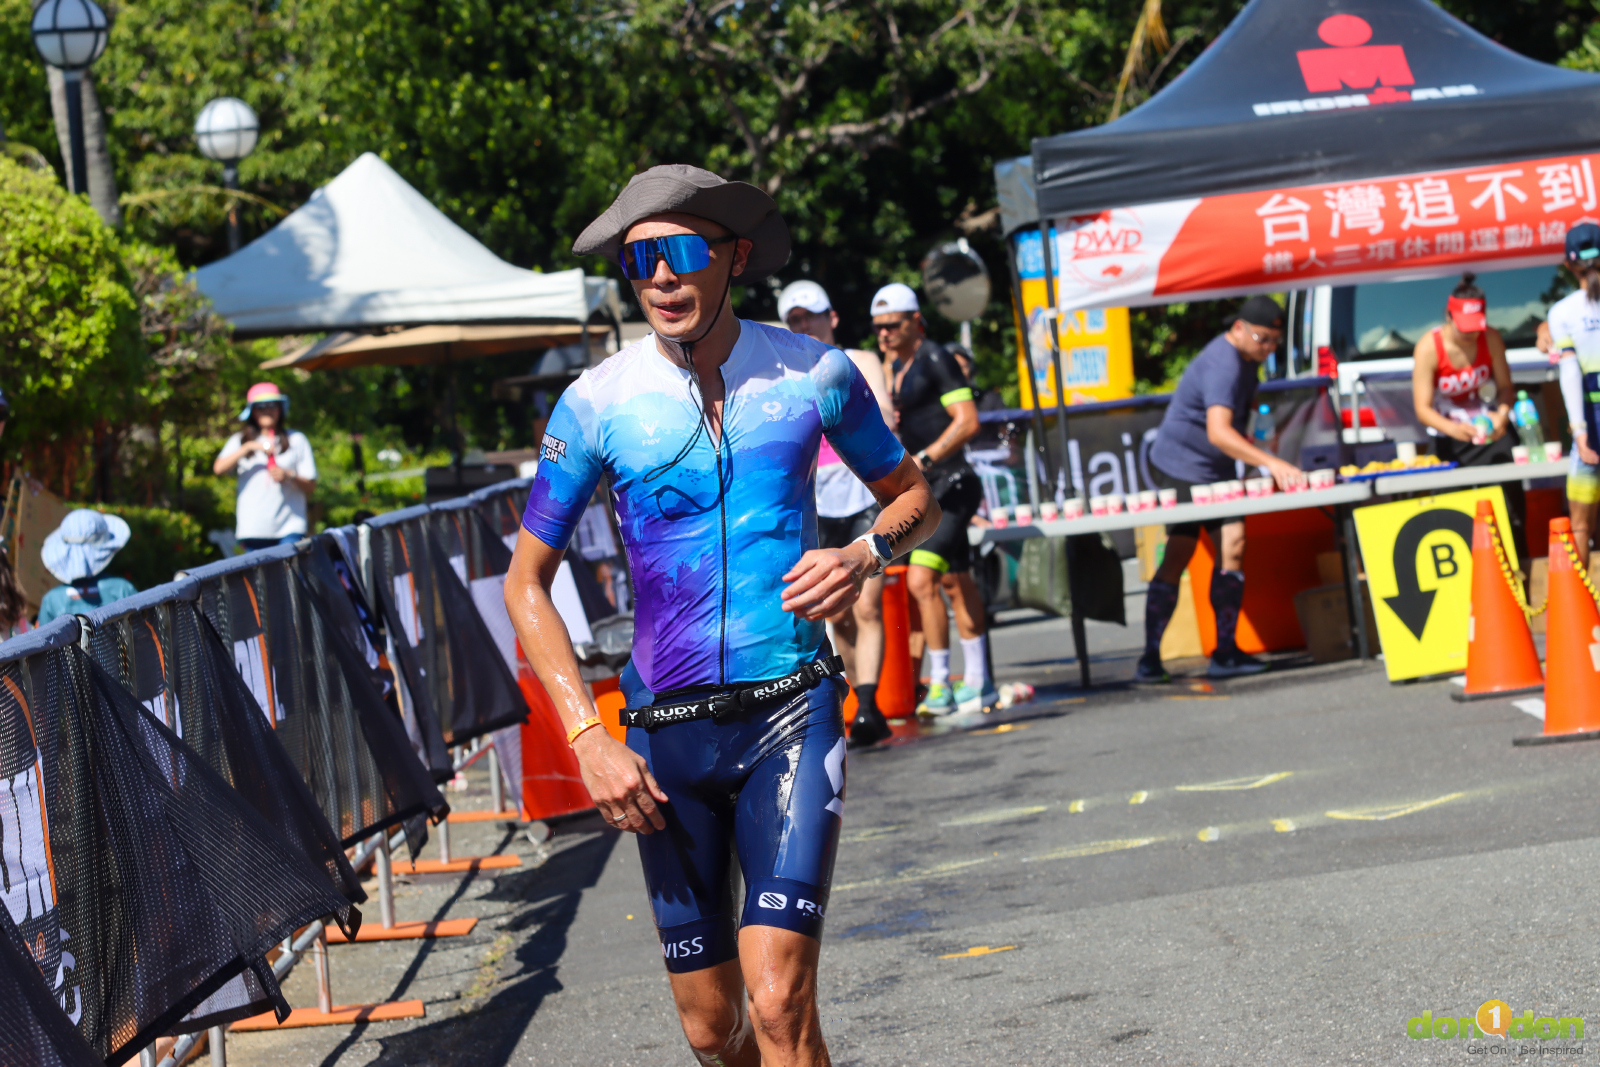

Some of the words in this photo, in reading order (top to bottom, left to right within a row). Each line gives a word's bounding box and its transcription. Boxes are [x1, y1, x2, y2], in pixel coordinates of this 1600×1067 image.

[1255, 158, 1597, 247] 台灣追不到
[1073, 228, 1143, 253] DWD
[1431, 543, 1459, 579] B
[754, 672, 802, 698] RUDY
[649, 704, 700, 718] RUDY
